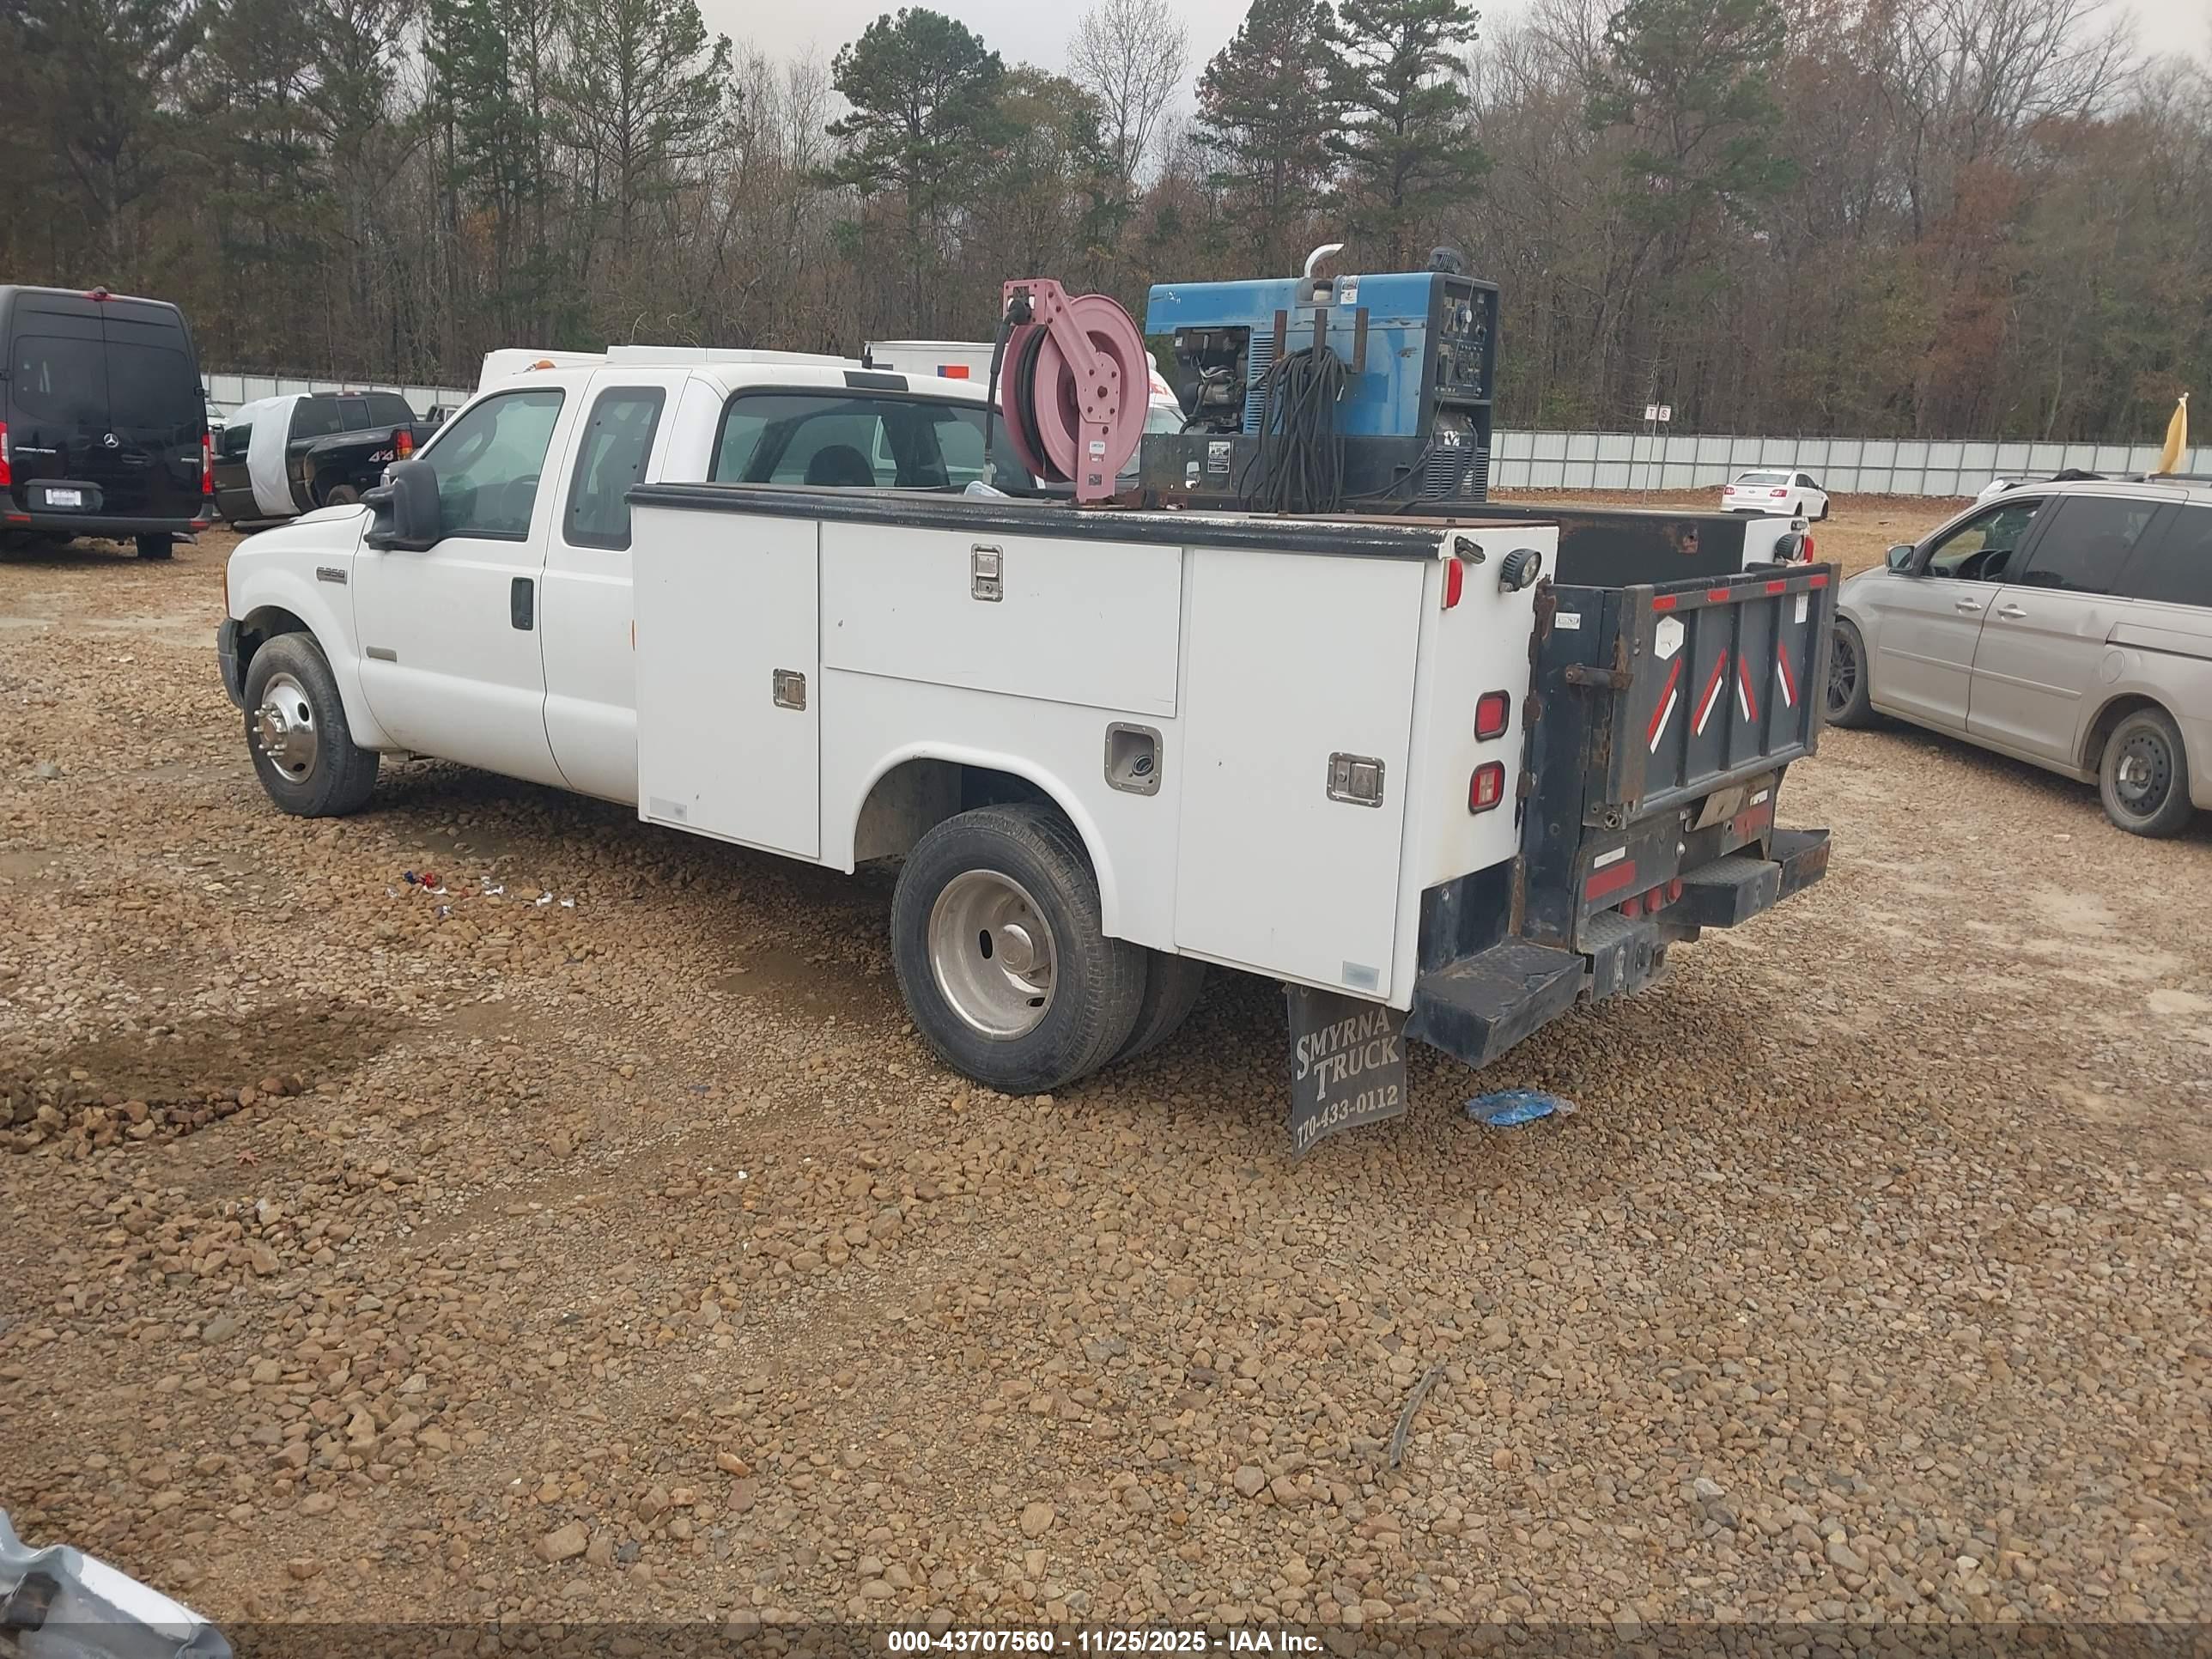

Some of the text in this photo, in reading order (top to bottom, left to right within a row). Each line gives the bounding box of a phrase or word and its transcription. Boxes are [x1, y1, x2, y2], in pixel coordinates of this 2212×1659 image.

[1662, 409, 1668, 418] S
[1296, 1006, 1391, 1081] SMYRNA
[1313, 1035, 1400, 1103] TRUCK
[1297, 1085, 1399, 1150] 770-433-0112
